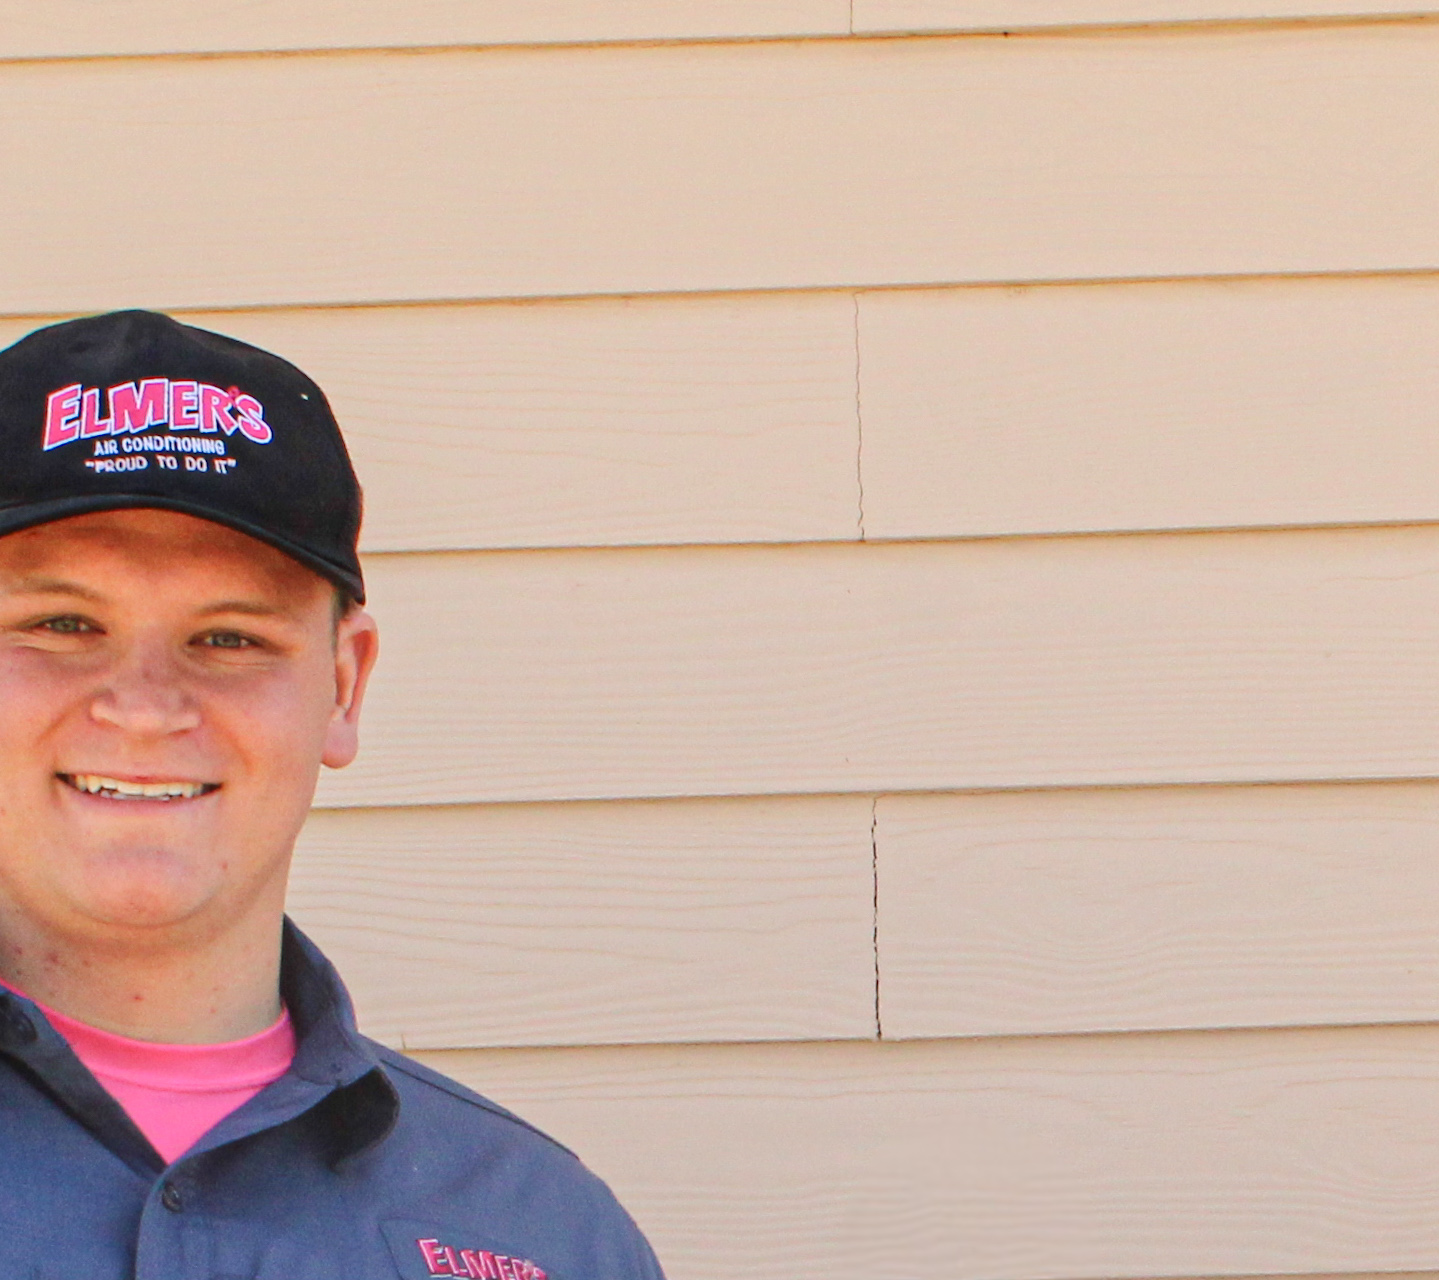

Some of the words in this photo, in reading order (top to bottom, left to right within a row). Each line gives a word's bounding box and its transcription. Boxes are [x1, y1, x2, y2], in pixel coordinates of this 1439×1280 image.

[43, 377, 273, 451] ELMER'S
[93, 438, 119, 456] AIR
[121, 435, 225, 456] CONDITIONING
[84, 457, 148, 474] "PROUD
[156, 454, 178, 471] TO
[185, 456, 208, 473] DO
